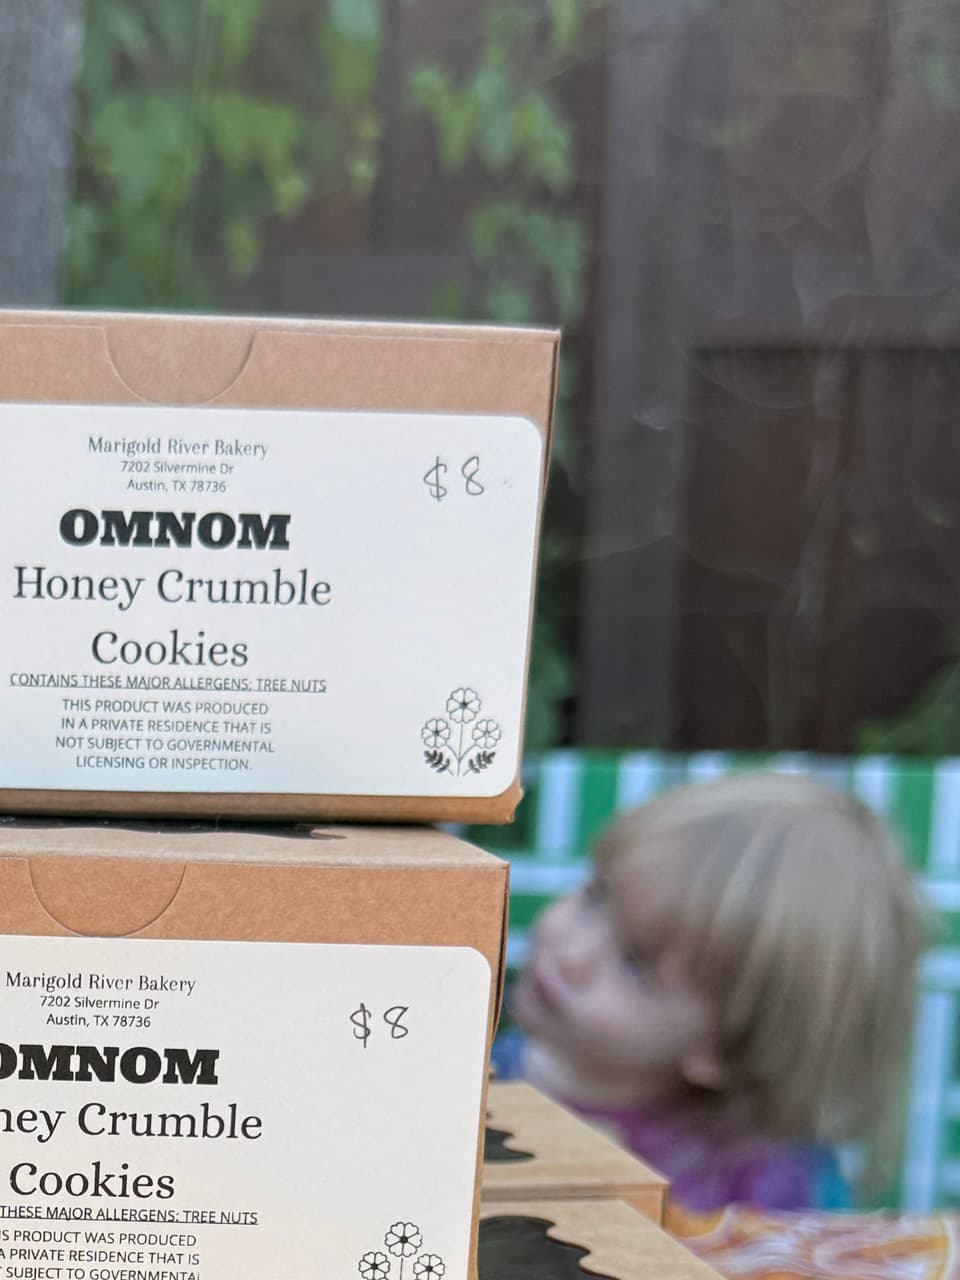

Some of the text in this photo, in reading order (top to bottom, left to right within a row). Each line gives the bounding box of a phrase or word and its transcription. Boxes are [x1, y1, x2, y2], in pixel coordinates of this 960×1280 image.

[88, 435, 269, 461] Marigold River Bakery
[120, 460, 234, 474] 7202 Silvermine Dr
[423, 455, 486, 502] $8
[126, 478, 226, 493] Austin, TX 78736
[58, 507, 291, 552] OMNOM
[13, 565, 333, 611] Honey Crumble
[91, 625, 249, 668] Cookies
[5, 970, 196, 997] Marigold River Bakery
[39, 994, 160, 1010] 7202 Silvermine Dr
[45, 1013, 151, 1028] Austin, TX 78736
[350, 1002, 411, 1048] $8
[77, 1098, 263, 1140] Crumble
[8, 1157, 175, 1200] Cookies
[46, 1206, 93, 1221] MAJOR
[95, 1207, 179, 1222] ALLERGENS:
[181, 1210, 216, 1223] TREE
[220, 1210, 258, 1224] NUTS
[13, 1229, 81, 1244] PRODUCT
[84, 1231, 115, 1244] WAS
[119, 1232, 197, 1247] PRODUCED
[9, 1247, 65, 1261] PRIVATE
[68, 1249, 144, 1264] RESIDENCE
[147, 1252, 184, 1265] THAT
[188, 1253, 200, 1266] IS
[65, 1267, 85, 1280] TO
